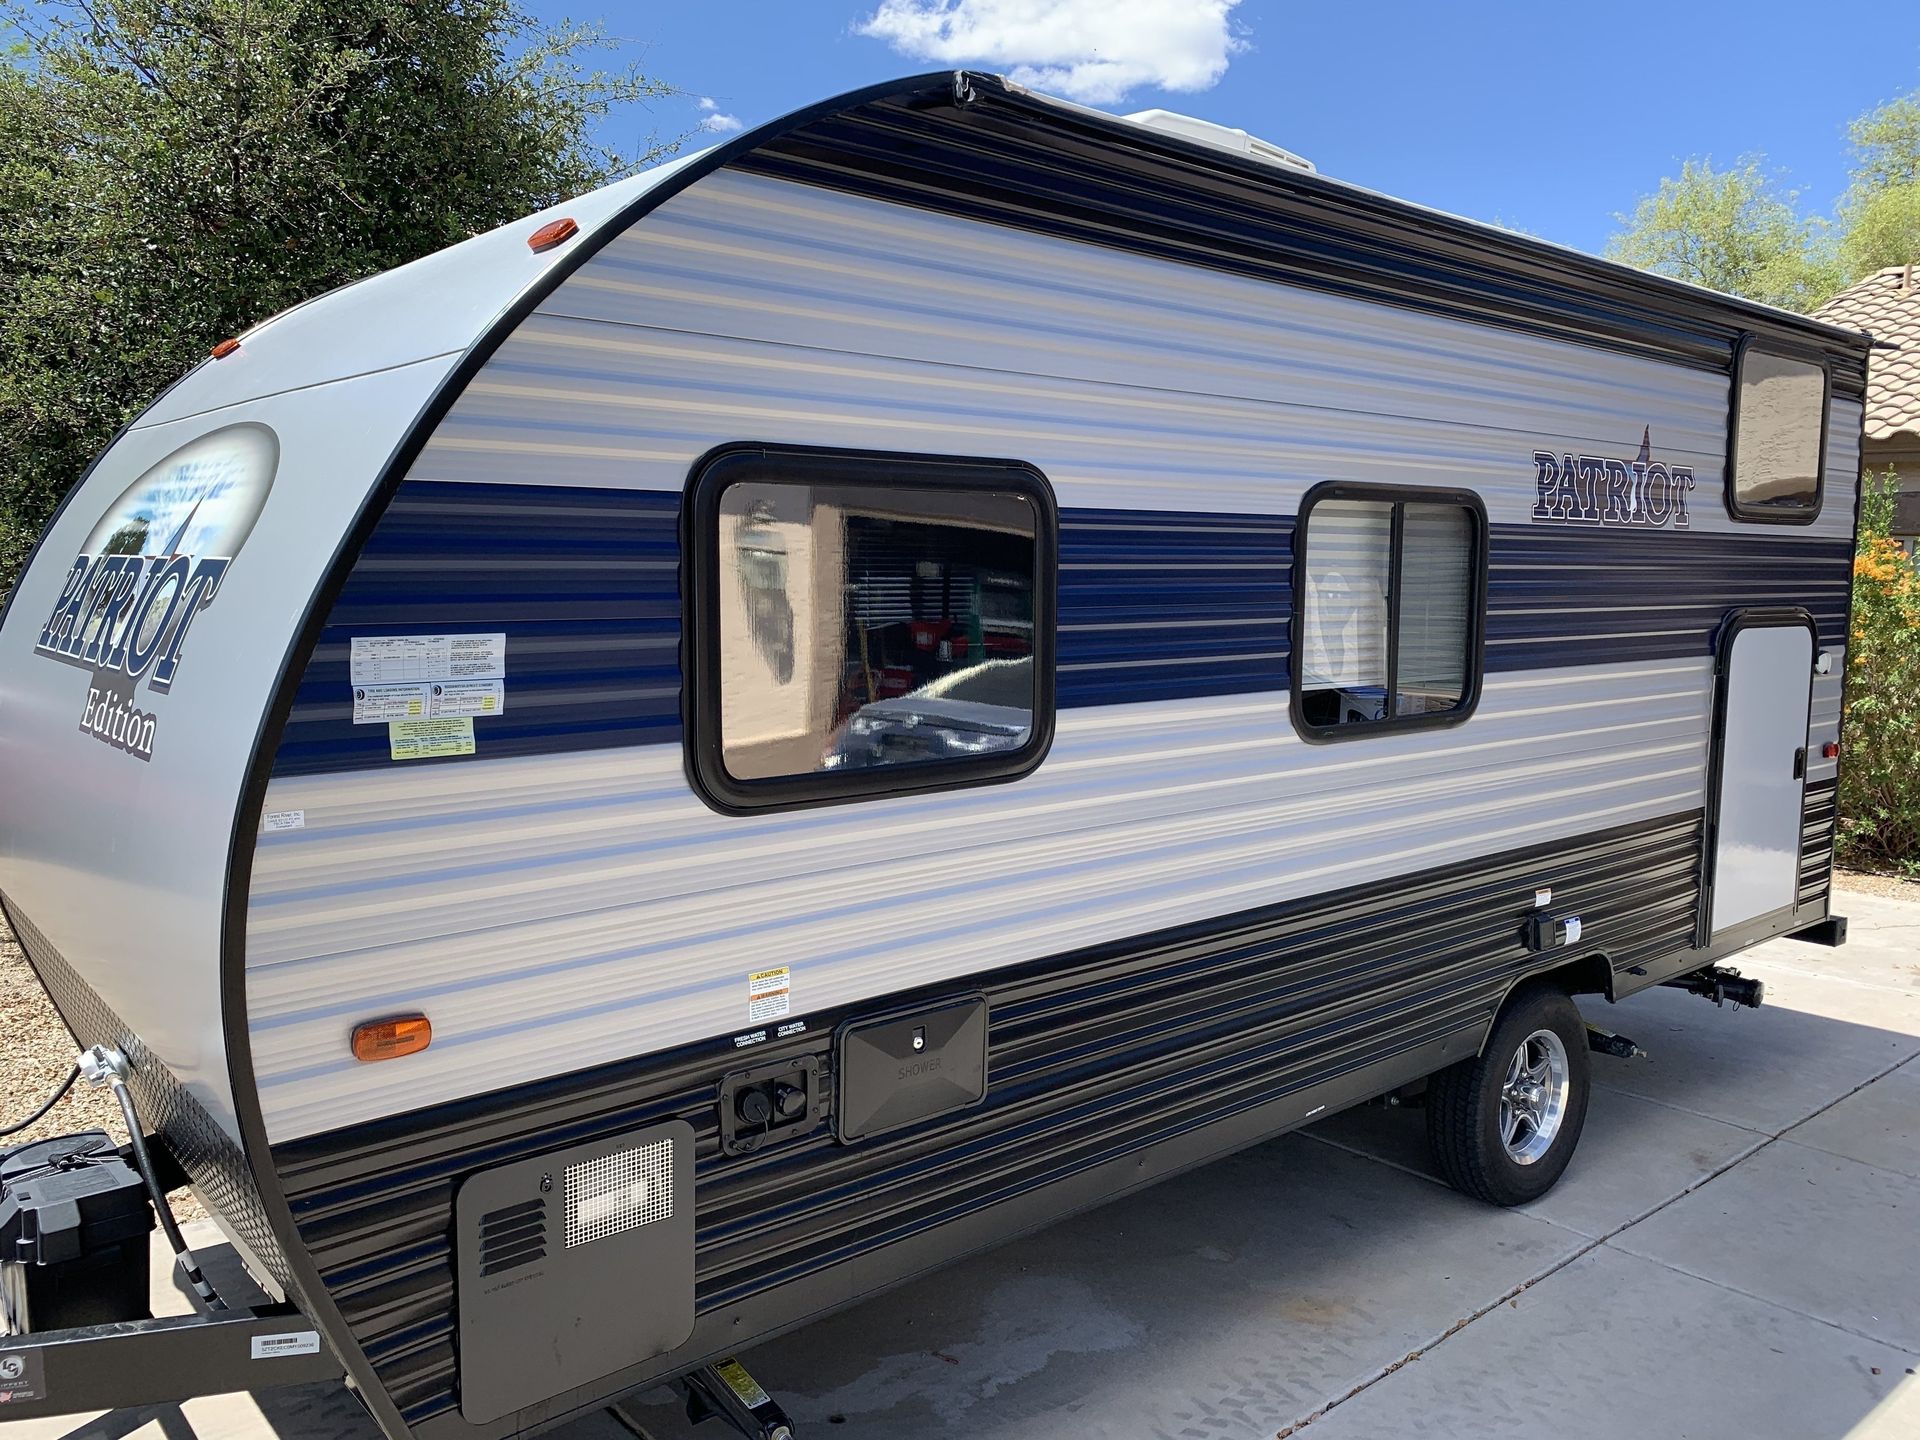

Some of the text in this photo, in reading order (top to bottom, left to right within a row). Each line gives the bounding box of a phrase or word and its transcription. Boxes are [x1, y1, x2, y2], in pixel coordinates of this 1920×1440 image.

[1532, 450, 1696, 526] PATRIOT
[35, 554, 233, 684] PATRIOT
[81, 687, 156, 754] Edition
[760, 969, 783, 977] CAUTION
[777, 1026, 806, 1037] CONNECTION
[788, 1021, 804, 1029] WATER
[734, 1030, 767, 1043] FRESH WATER
[736, 1035, 766, 1047] CONNECTION
[898, 1057, 942, 1080] SHOWER
